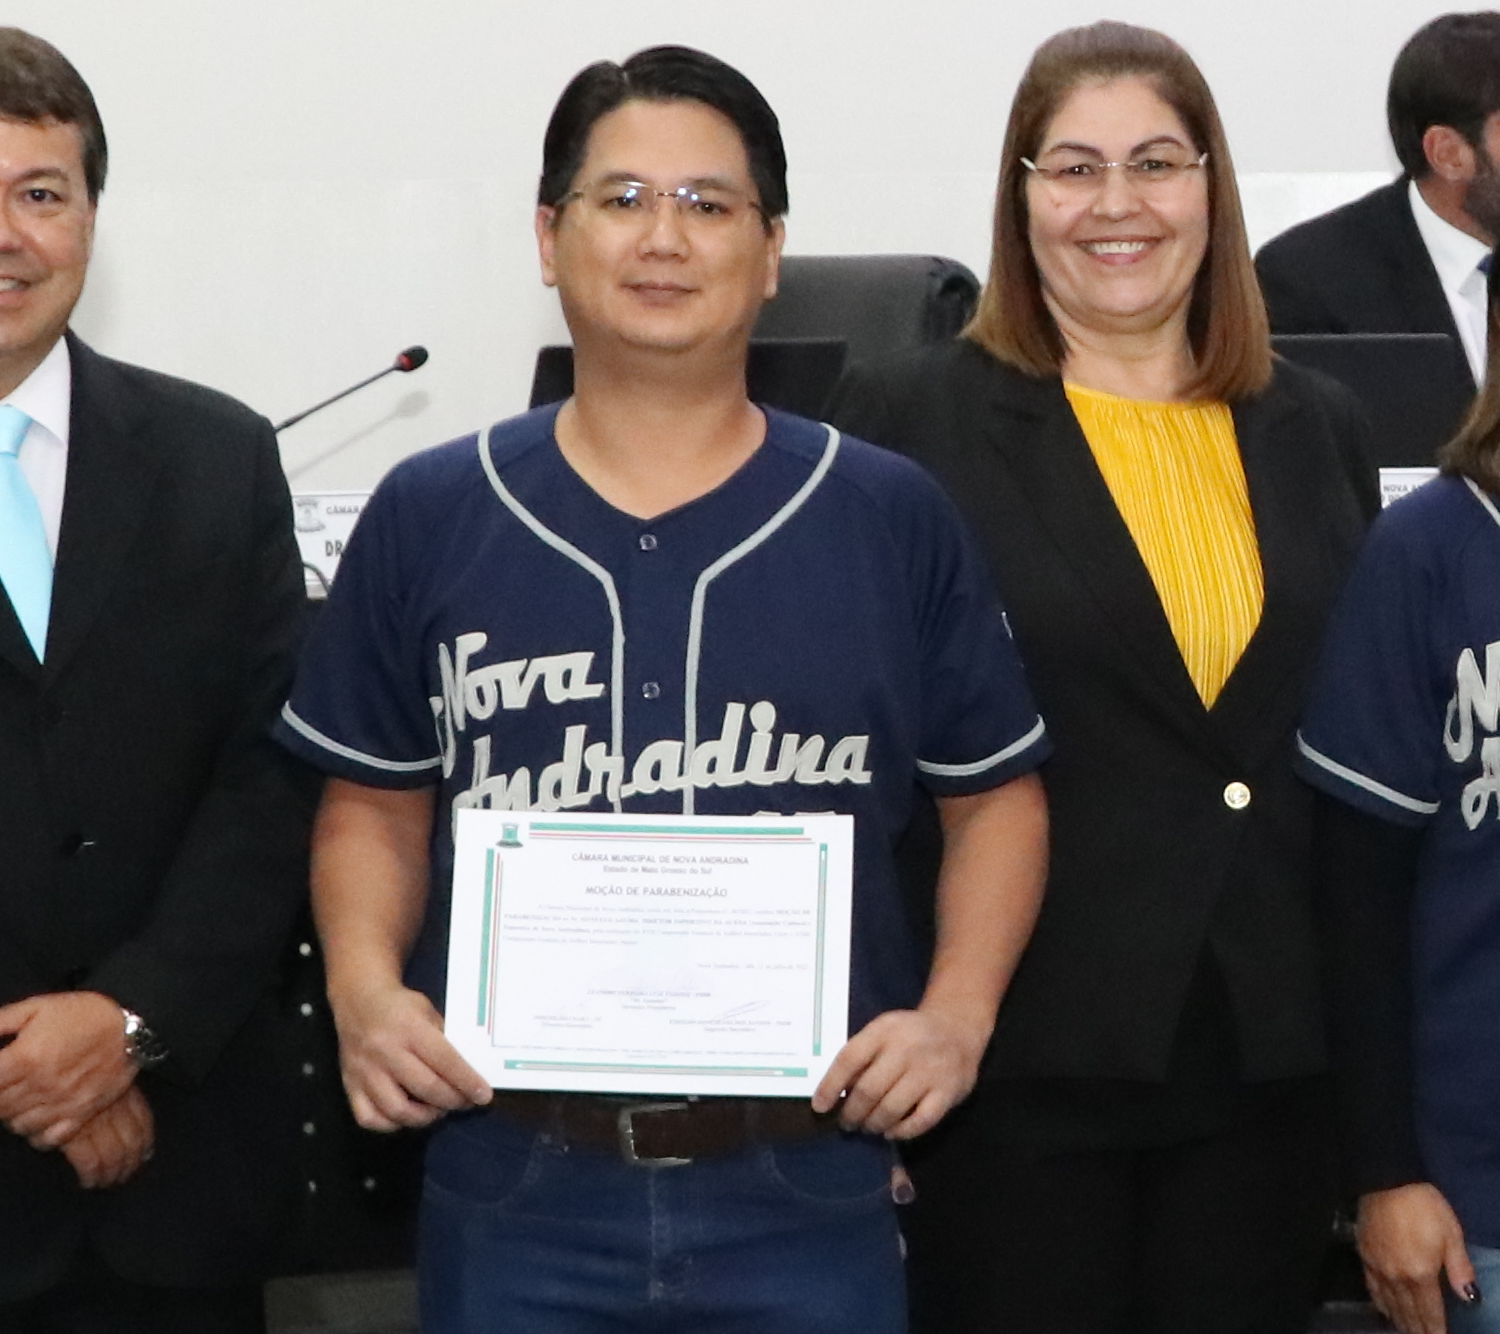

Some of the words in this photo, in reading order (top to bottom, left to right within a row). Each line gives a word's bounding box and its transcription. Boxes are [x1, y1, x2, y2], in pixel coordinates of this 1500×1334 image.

[429, 631, 606, 779] Nova
[659, 855, 670, 864] DE
[673, 855, 697, 864] NOVA
[585, 884, 623, 897] MOÇÃO
[626, 886, 639, 896] DE
[643, 886, 728, 898] PARABENIZAÇÃO
